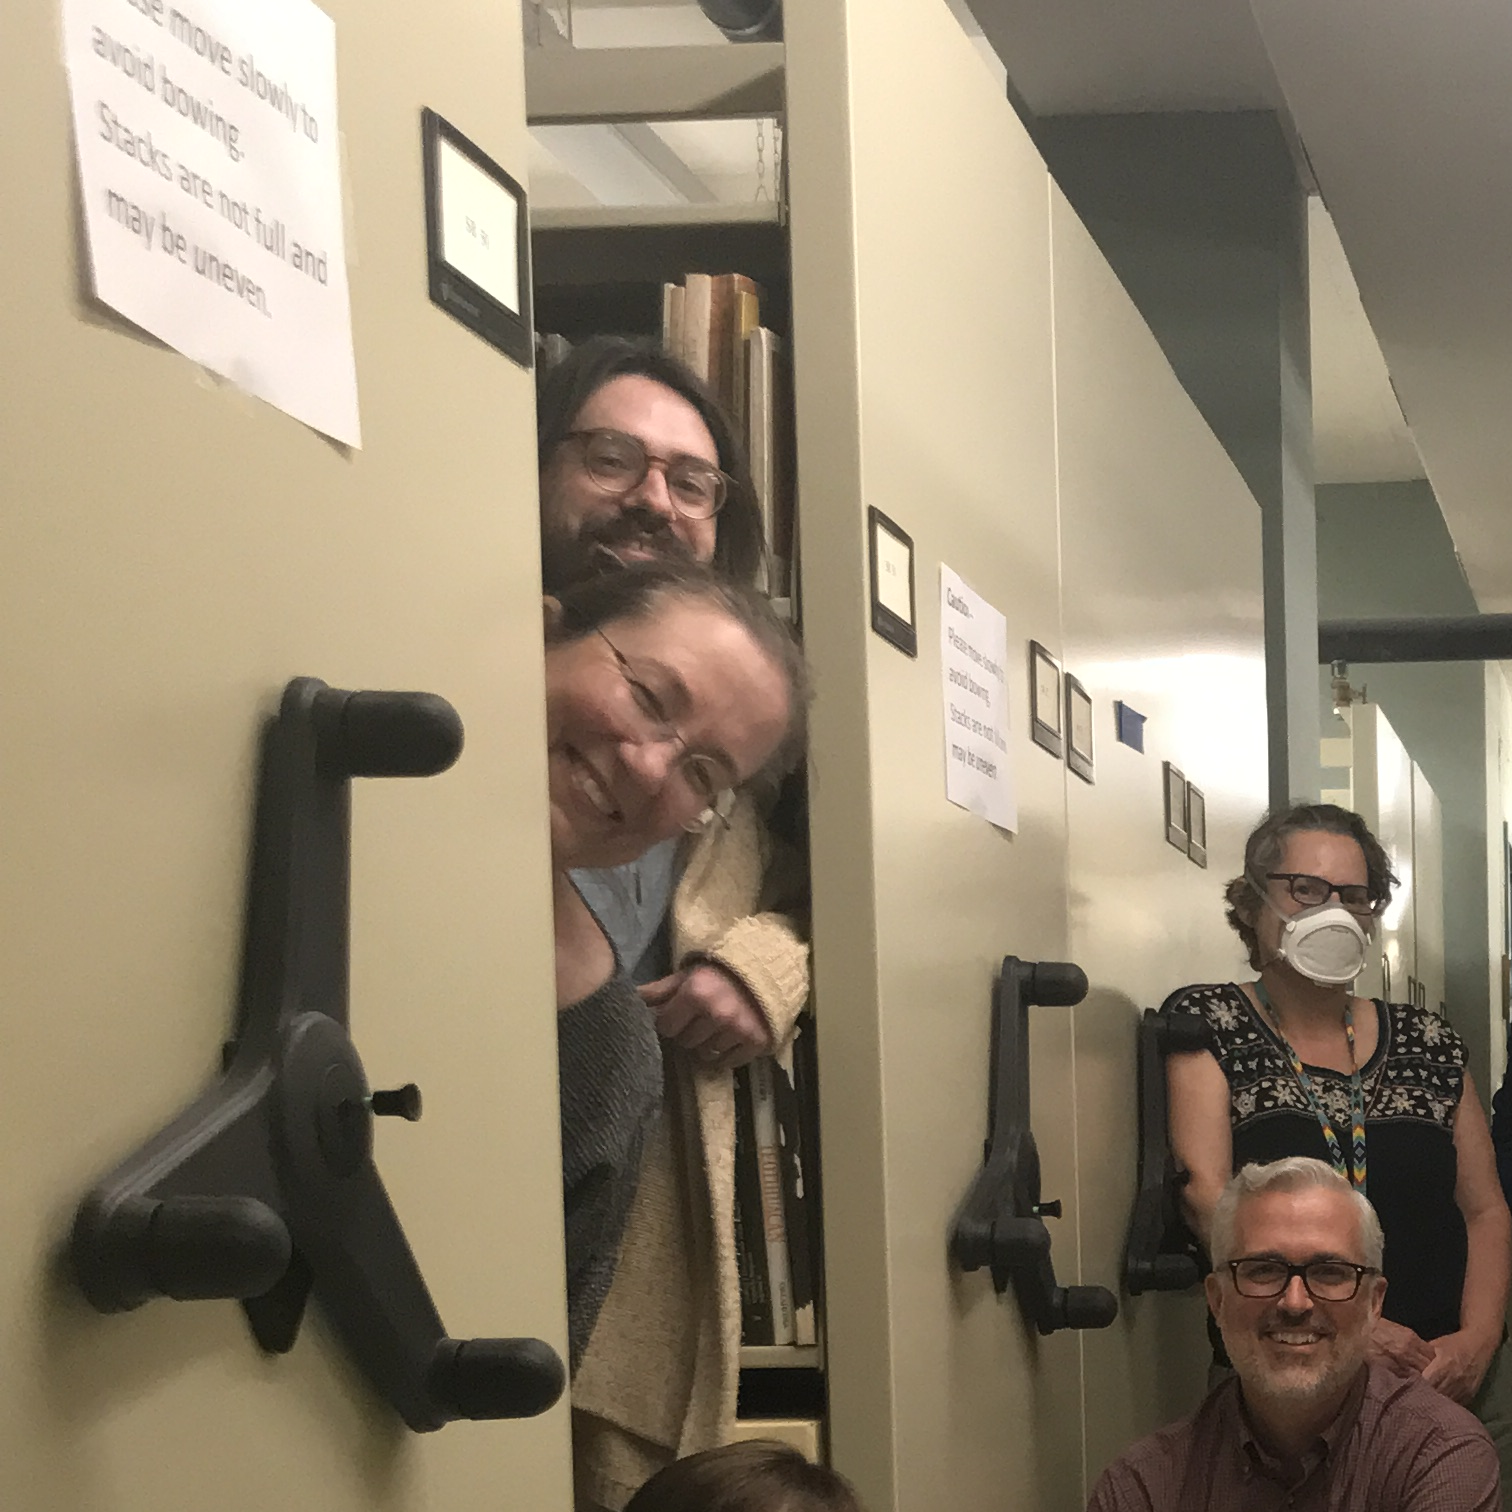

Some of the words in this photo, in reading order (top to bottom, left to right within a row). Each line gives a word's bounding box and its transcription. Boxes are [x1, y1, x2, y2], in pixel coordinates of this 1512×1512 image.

[91, 24, 155, 94] avoid
[159, 64, 244, 163] bowing.
[169, 8, 232, 76] move
[237, 53, 299, 133] slowly
[300, 103, 318, 143] to
[95, 100, 172, 182] Stacks
[177, 163, 213, 209] are
[218, 189, 250, 237] not
[253, 206, 286, 262] full
[291, 239, 327, 286] and
[105, 188, 155, 252] may
[160, 210, 187, 265] be
[193, 244, 272, 319] uneven.
